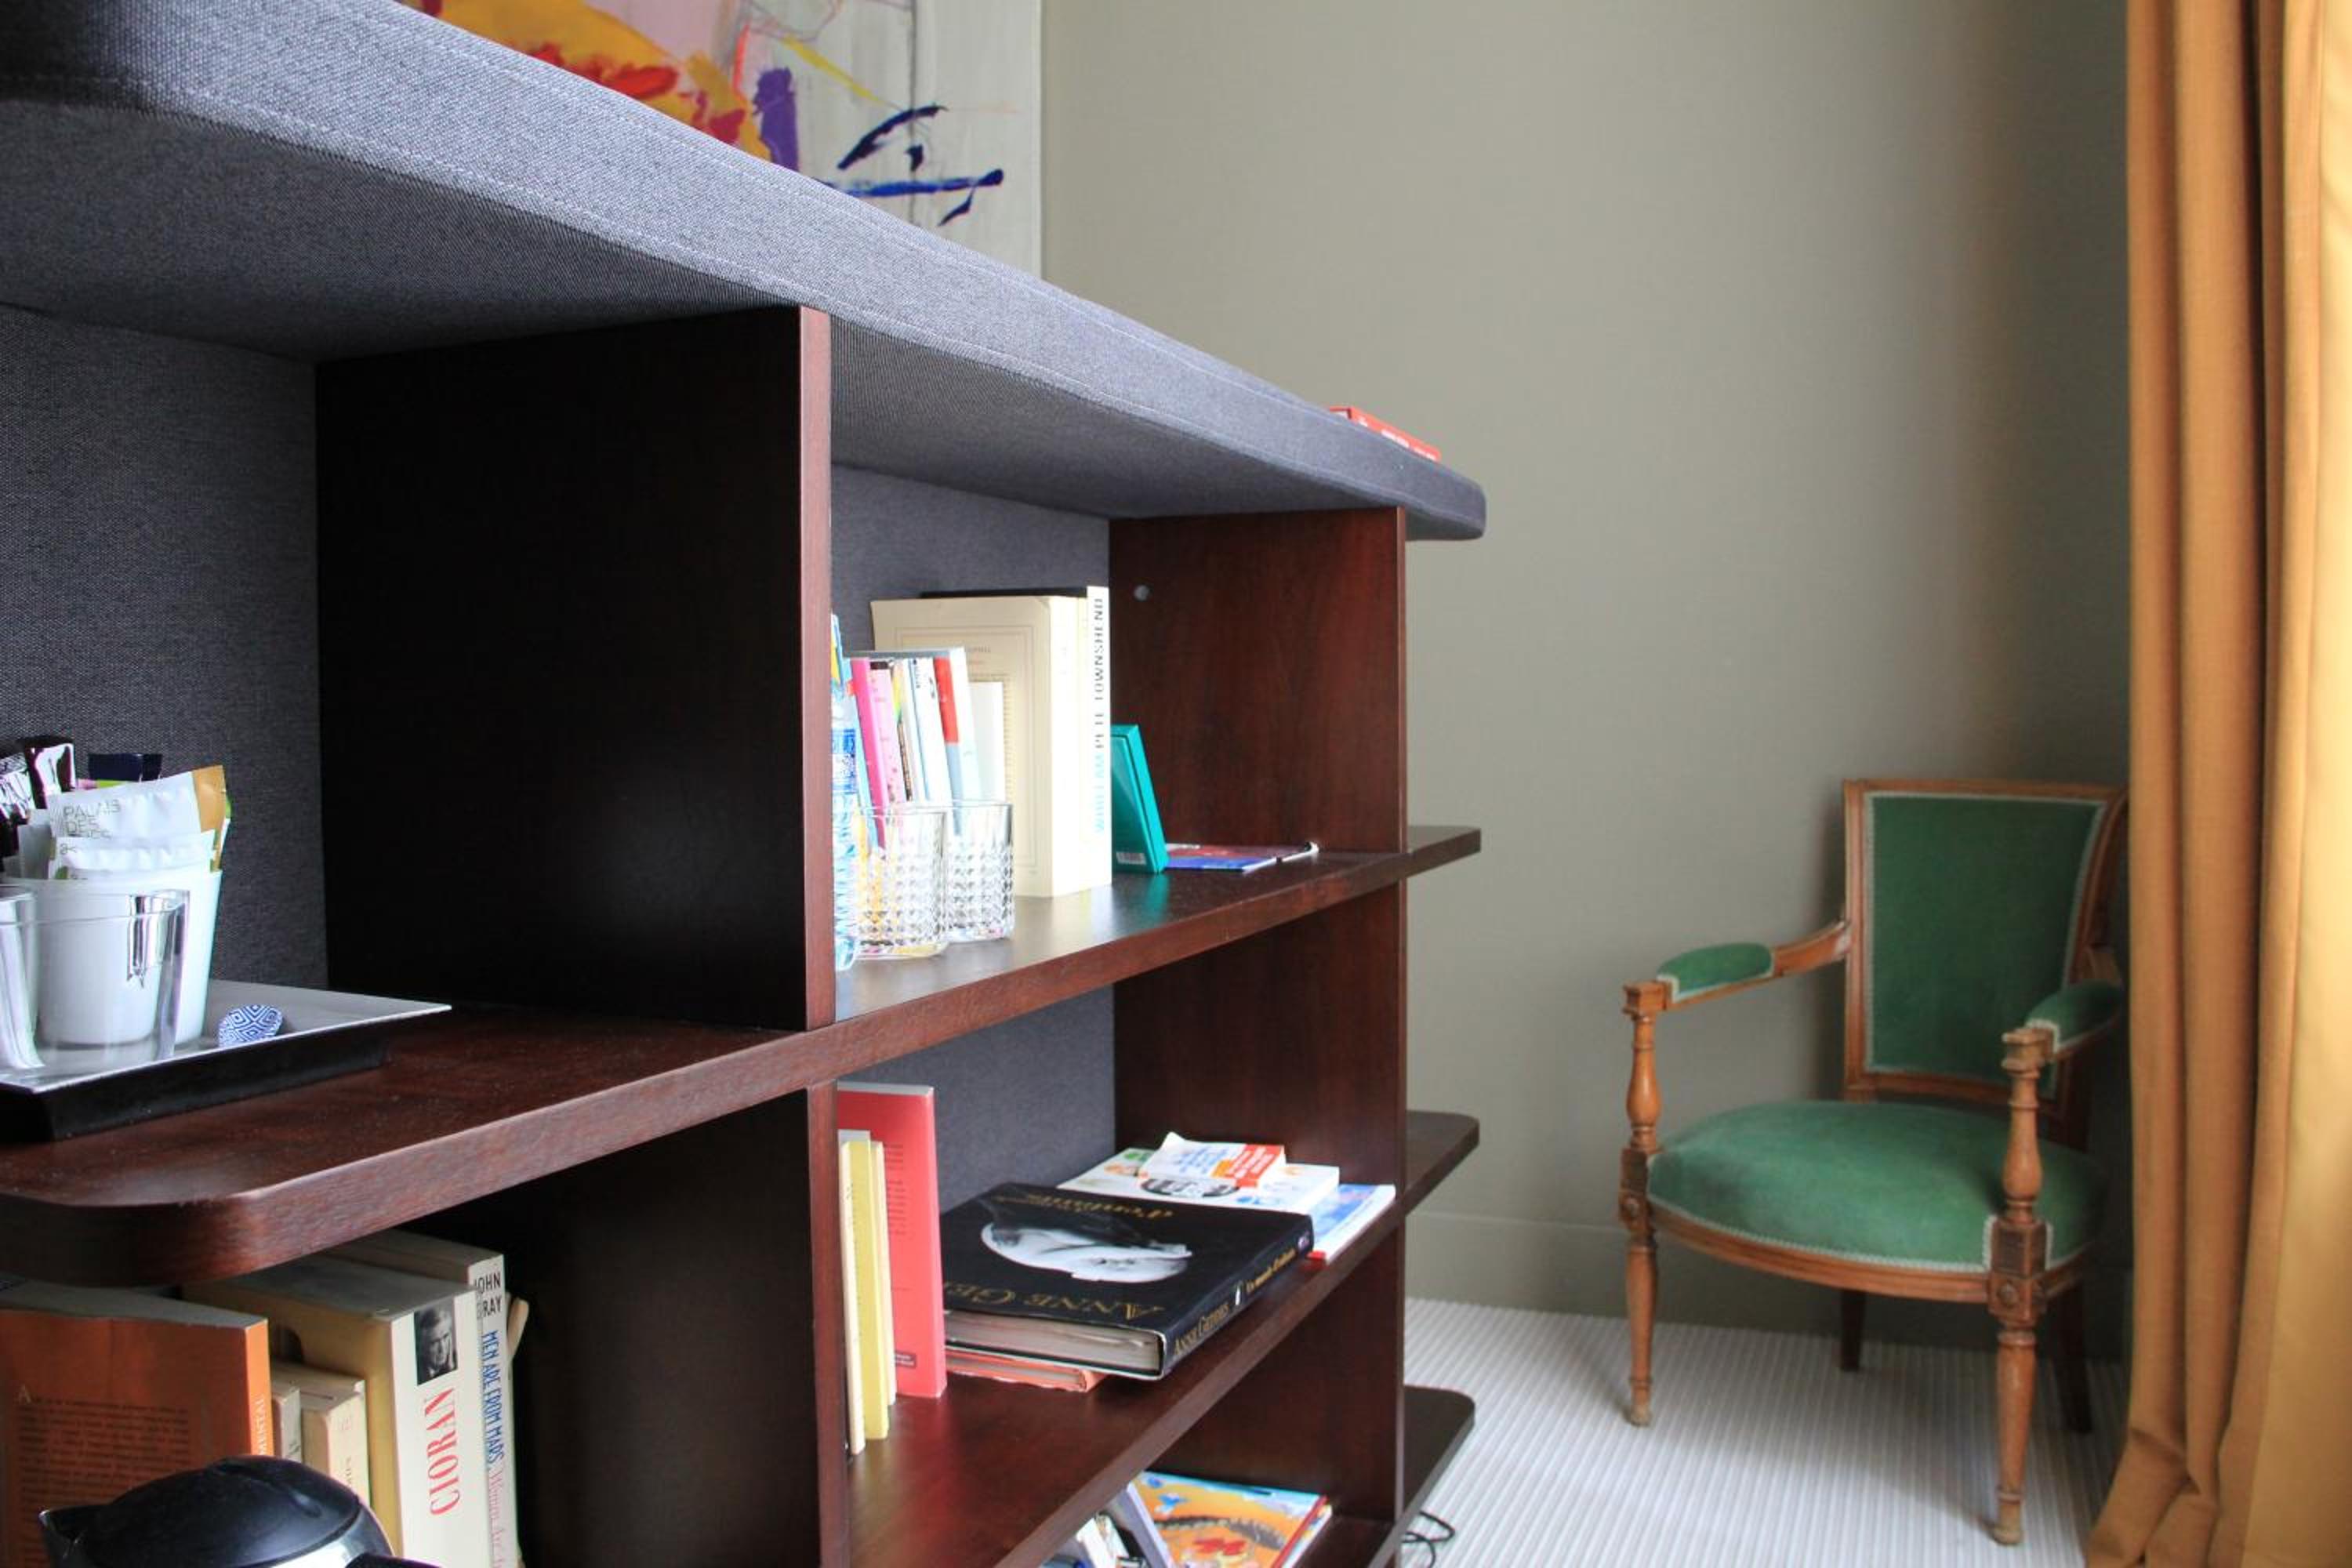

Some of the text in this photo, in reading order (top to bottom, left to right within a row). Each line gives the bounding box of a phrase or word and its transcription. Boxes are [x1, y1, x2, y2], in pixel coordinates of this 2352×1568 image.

[63, 798, 122, 820] PALAIS
[66, 815, 100, 835] DES
[1024, 1293, 1166, 1321] ANNE
[482, 1329, 499, 1362] MEN
[483, 1363, 502, 1390] ARE
[484, 1389, 504, 1428] FROM
[424, 1387, 461, 1515] CIORAN
